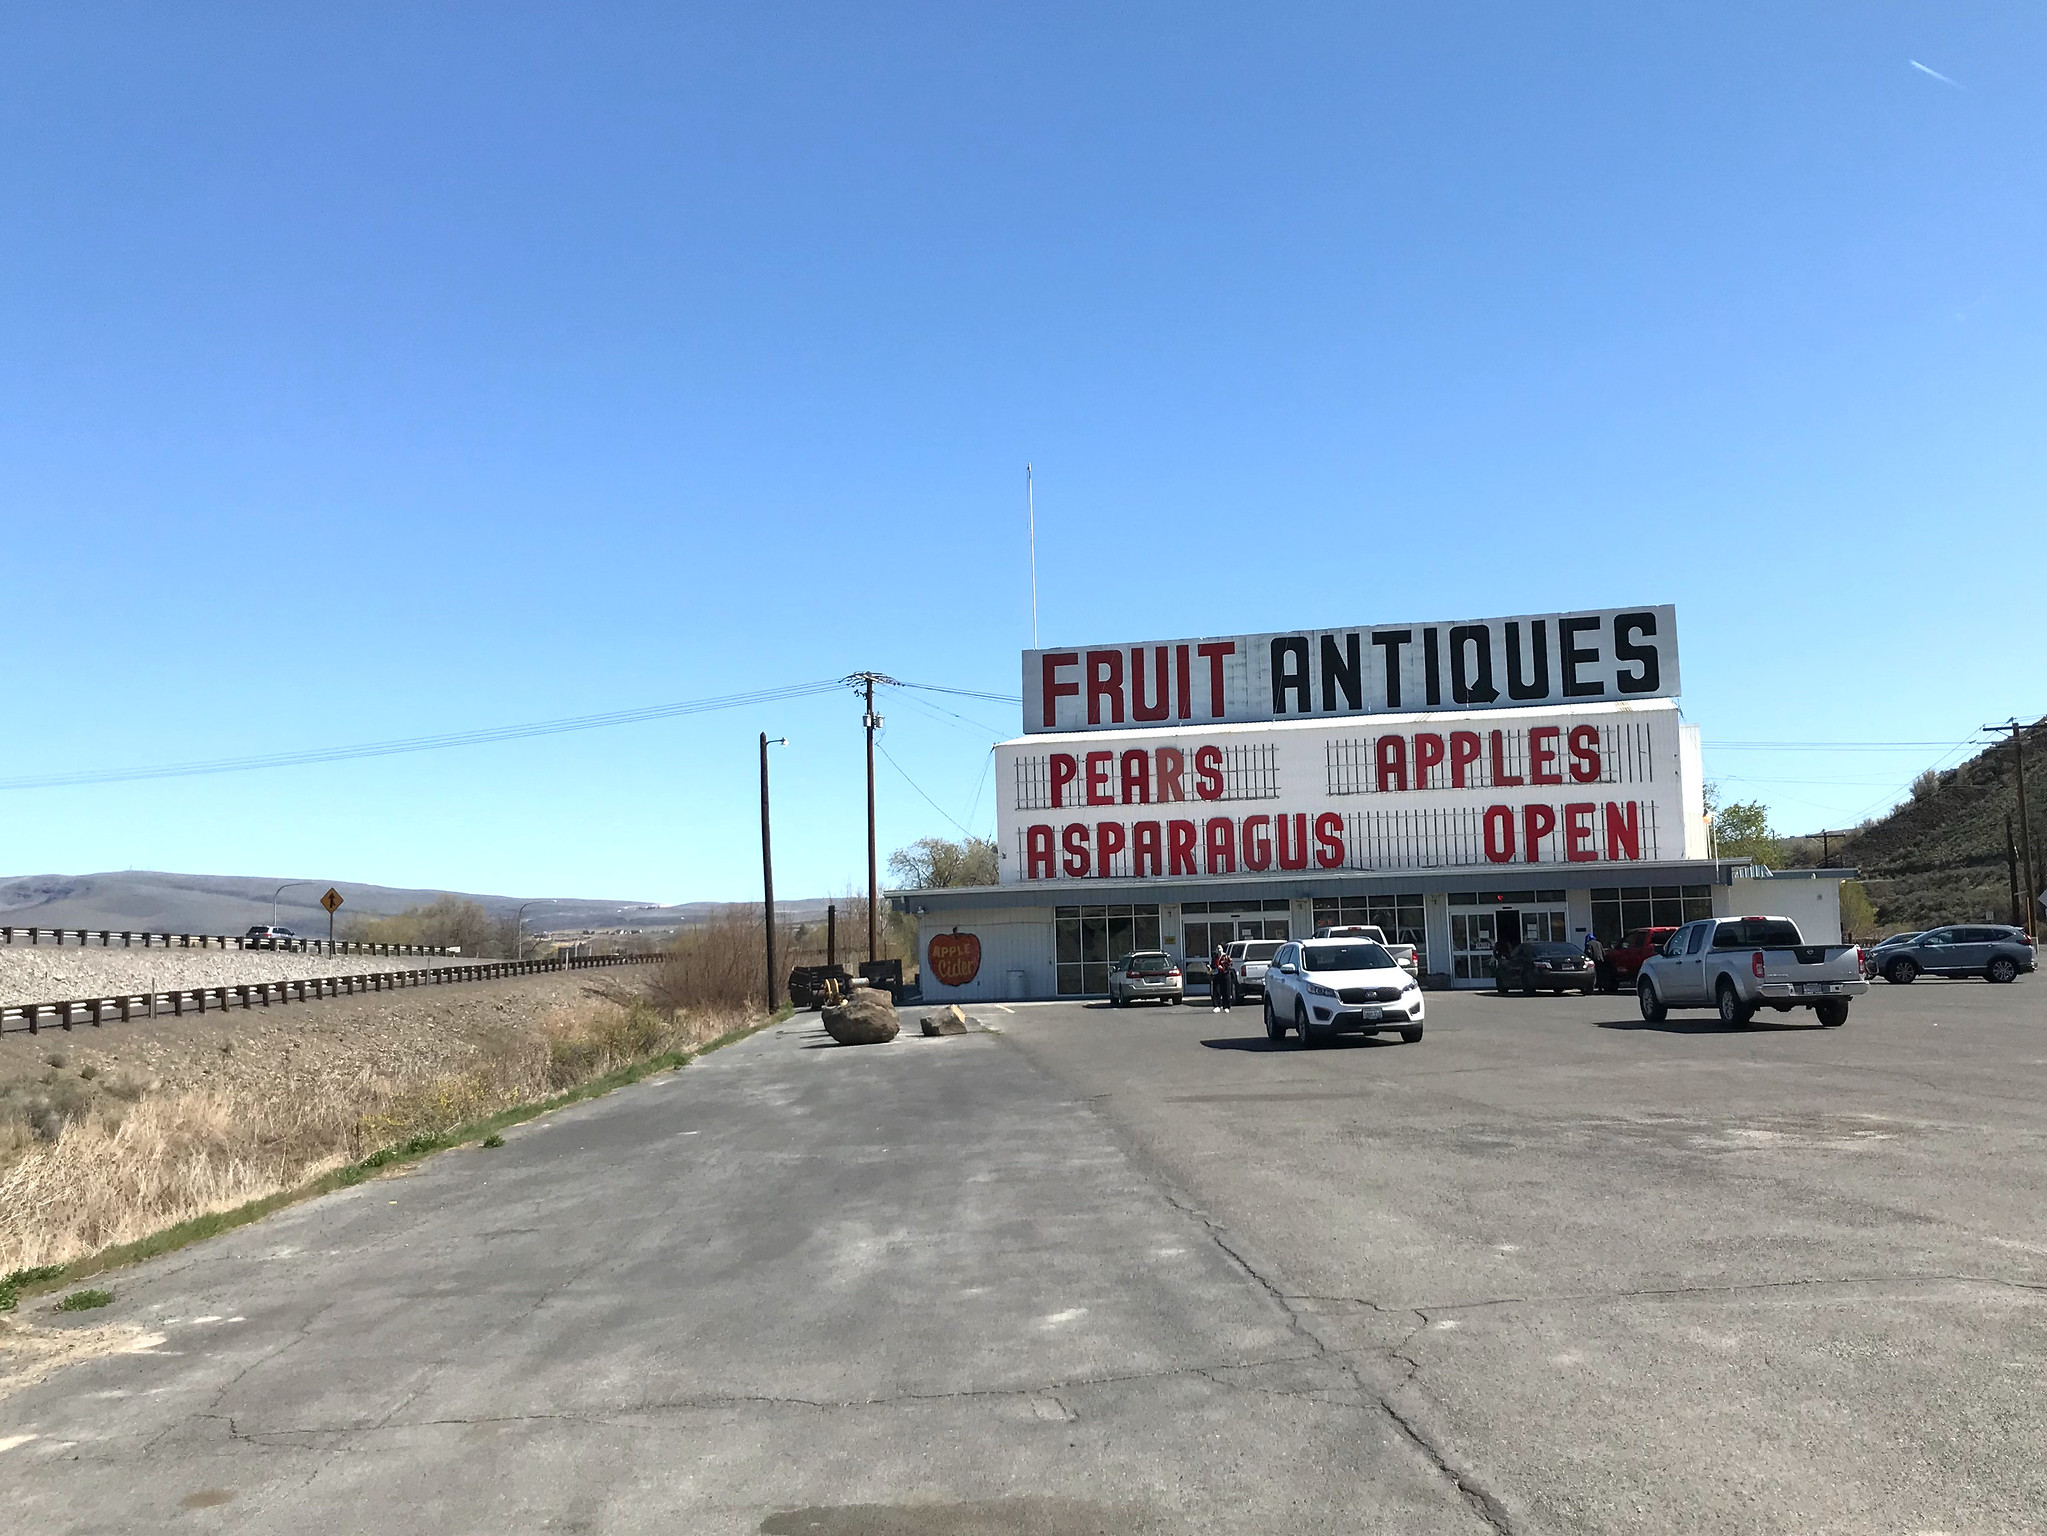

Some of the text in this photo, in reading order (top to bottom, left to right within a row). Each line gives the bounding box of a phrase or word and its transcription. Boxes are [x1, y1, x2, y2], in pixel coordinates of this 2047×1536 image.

[1043, 612, 1660, 727] FRUIT ANTIQUES
[1050, 745, 1224, 808] PEARS
[1377, 725, 1601, 792] APPLES
[1028, 812, 1345, 879] ASPARAGUS
[1484, 801, 1640, 864] OPEN
[932, 943, 971, 958] APPLE
[938, 958, 974, 978] Cider
